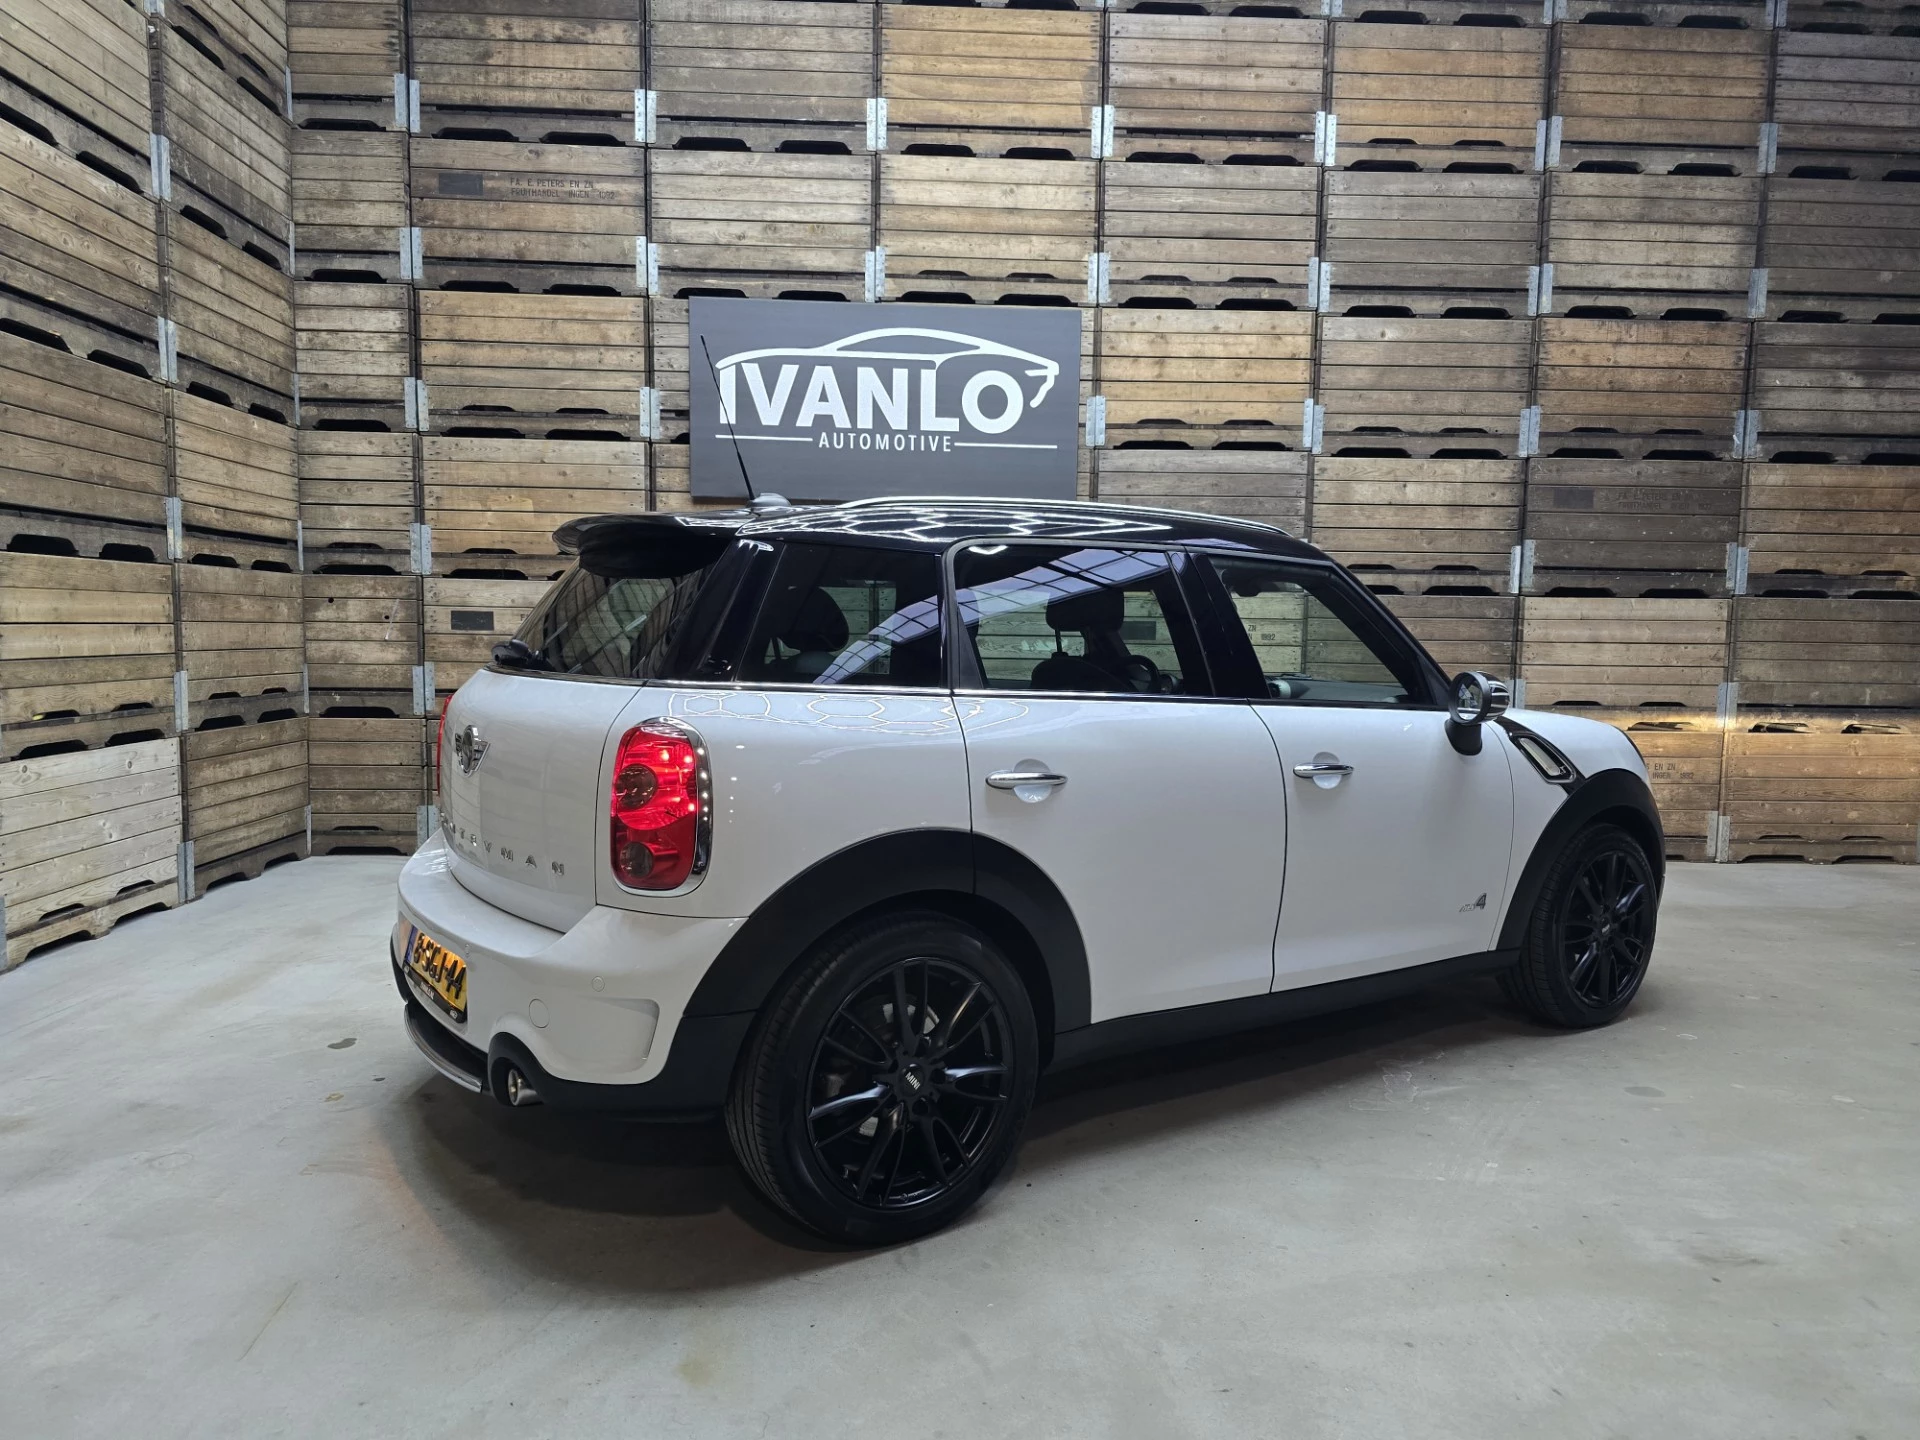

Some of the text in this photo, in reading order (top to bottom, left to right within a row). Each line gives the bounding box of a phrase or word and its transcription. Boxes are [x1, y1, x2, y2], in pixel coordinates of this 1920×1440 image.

[536, 178, 565, 188] PETERS
[569, 180, 580, 188] EN
[569, 190, 590, 199] INGEN
[818, 432, 952, 452] AUTOMOTIVE
[1654, 762, 1664, 771] EN
[1667, 763, 1676, 771] ZN
[905, 1071, 921, 1090] MINI
